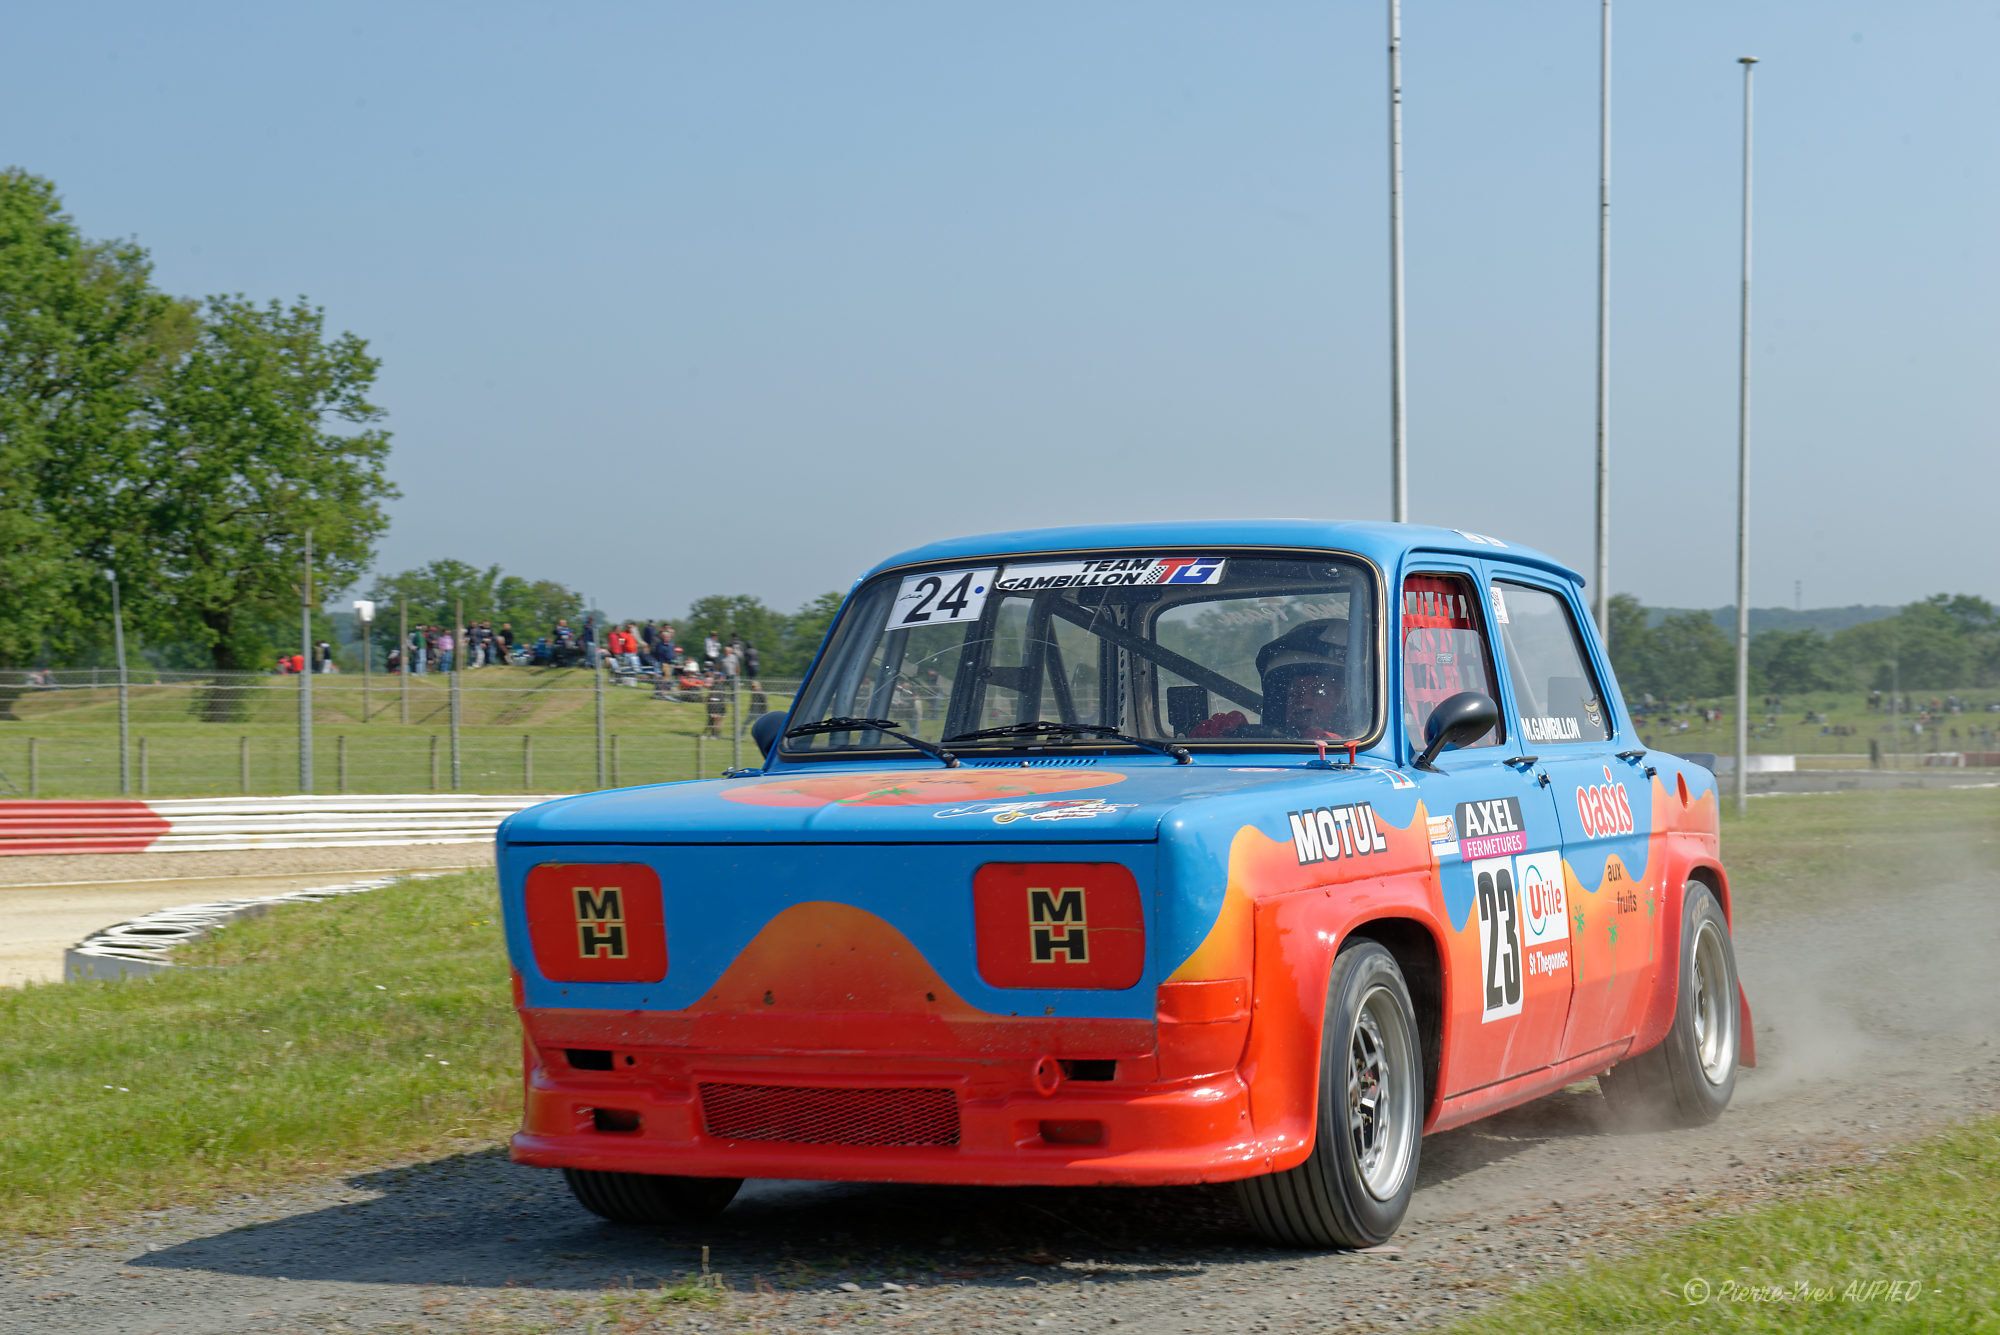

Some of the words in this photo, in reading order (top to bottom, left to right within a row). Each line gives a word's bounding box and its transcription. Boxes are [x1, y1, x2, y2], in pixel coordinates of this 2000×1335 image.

[1082, 558, 1154, 573] TEAM
[1155, 557, 1226, 584] TG
[999, 572, 1144, 590] GAMBILLON
[902, 573, 975, 624] 24
[1520, 717, 1581, 740] M.GAMBILLON
[1576, 765, 1633, 839] oasis
[1464, 800, 1518, 838] AXEL
[1288, 802, 1387, 865] MOTUL
[1467, 835, 1523, 858] FERMETURES
[1608, 863, 1622, 881] aux
[1529, 880, 1562, 920] Utile
[1617, 889, 1637, 914] fruits
[1477, 868, 1520, 1011] 23
[1529, 952, 1536, 976] St
